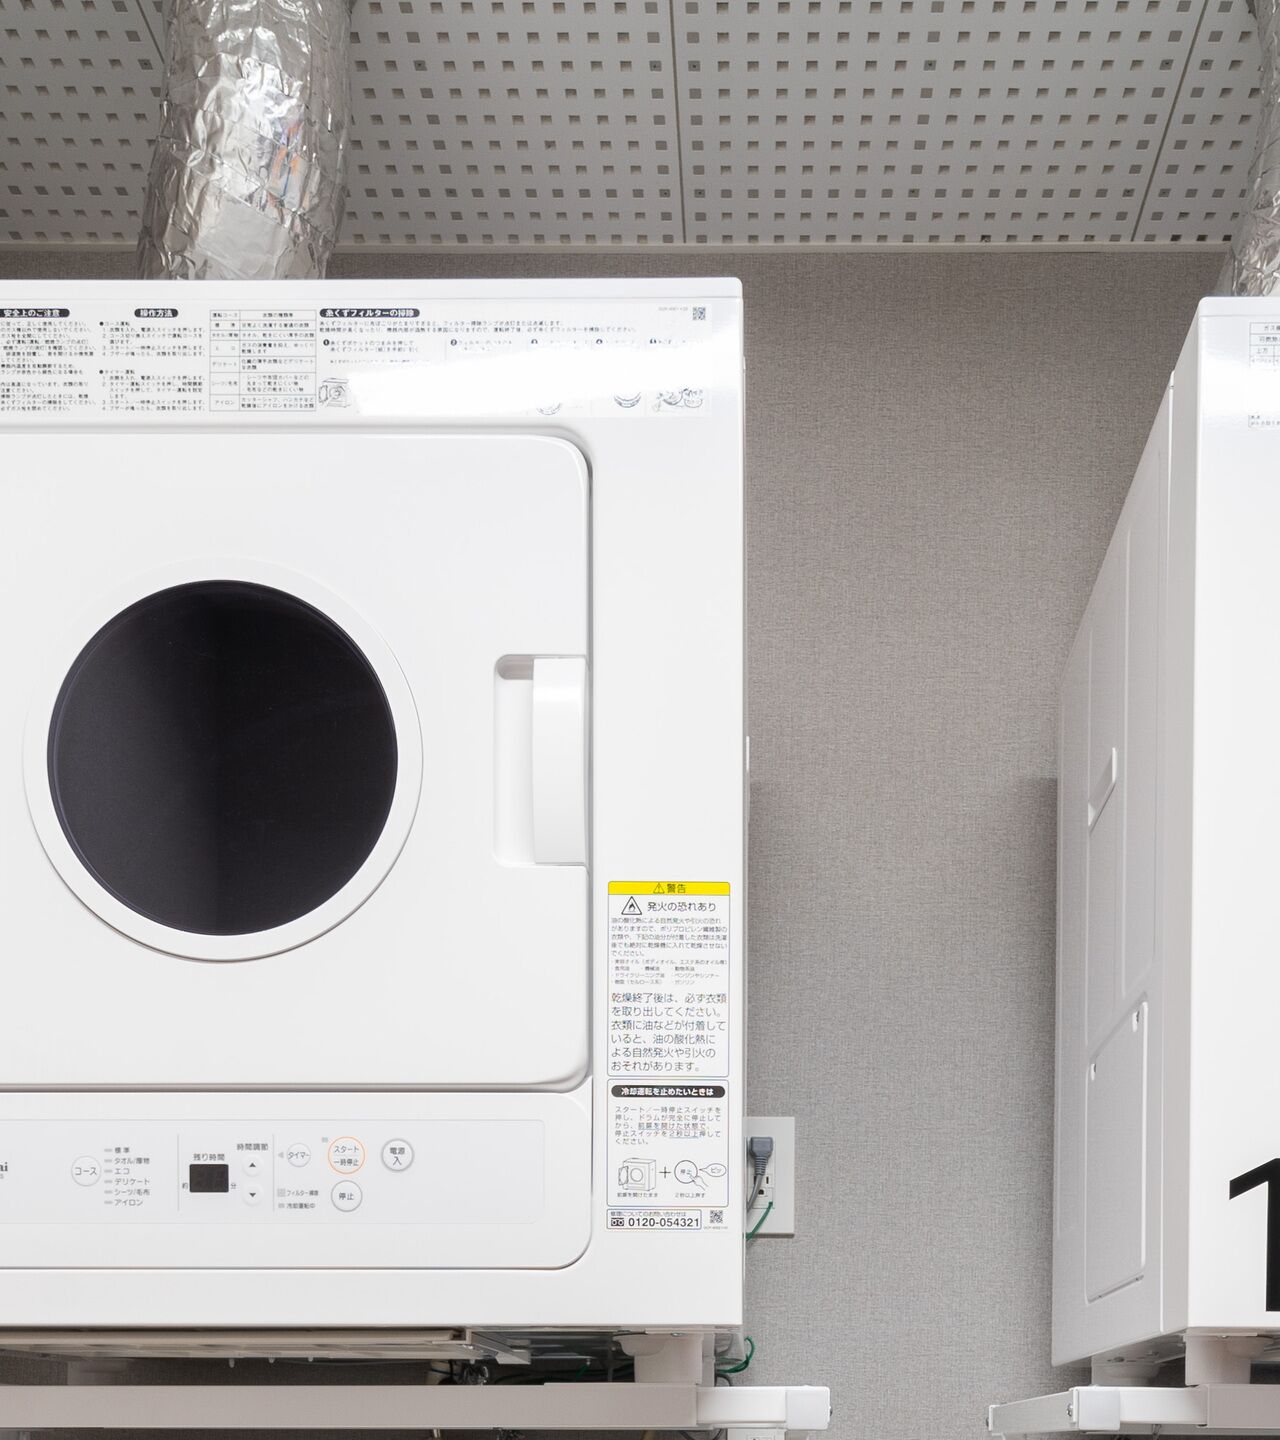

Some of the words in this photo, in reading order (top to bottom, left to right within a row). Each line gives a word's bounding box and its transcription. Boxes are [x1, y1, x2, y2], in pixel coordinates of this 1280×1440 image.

[3, 309, 60, 318] 安全上のご注意
[140, 309, 172, 318] 操作方法
[325, 309, 415, 318] 糸くずフィルターの掃除
[666, 883, 687, 894] 警告
[647, 901, 717, 913] 発火の恐れあり
[611, 992, 727, 1005] 乾燥終了後は、必ず衣類
[611, 1005, 721, 1018] を取り出してください。
[611, 1019, 727, 1032] 衣類に油などが付着して
[610, 1033, 716, 1045] いると、油の酸化熱に
[611, 1046, 717, 1059] よる自然発火や引火の
[610, 1060, 699, 1072] おそれがあります。
[621, 1087, 714, 1096] 冷却運転を止めたいときは
[236, 1142, 269, 1152] 時間調節
[333, 1144, 360, 1154] スタート
[192, 1152, 226, 1162] 残り時間
[286, 1151, 311, 1161] タイマー
[74, 1166, 98, 1176] コース
[114, 1167, 131, 1176] エコ
[114, 1177, 150, 1186] デリケート
[114, 1188, 151, 1197] シーツ/毛布
[338, 1191, 355, 1201] 停止
[114, 1198, 144, 1207] アイロン
[627, 1217, 699, 1228] 0120-054321
